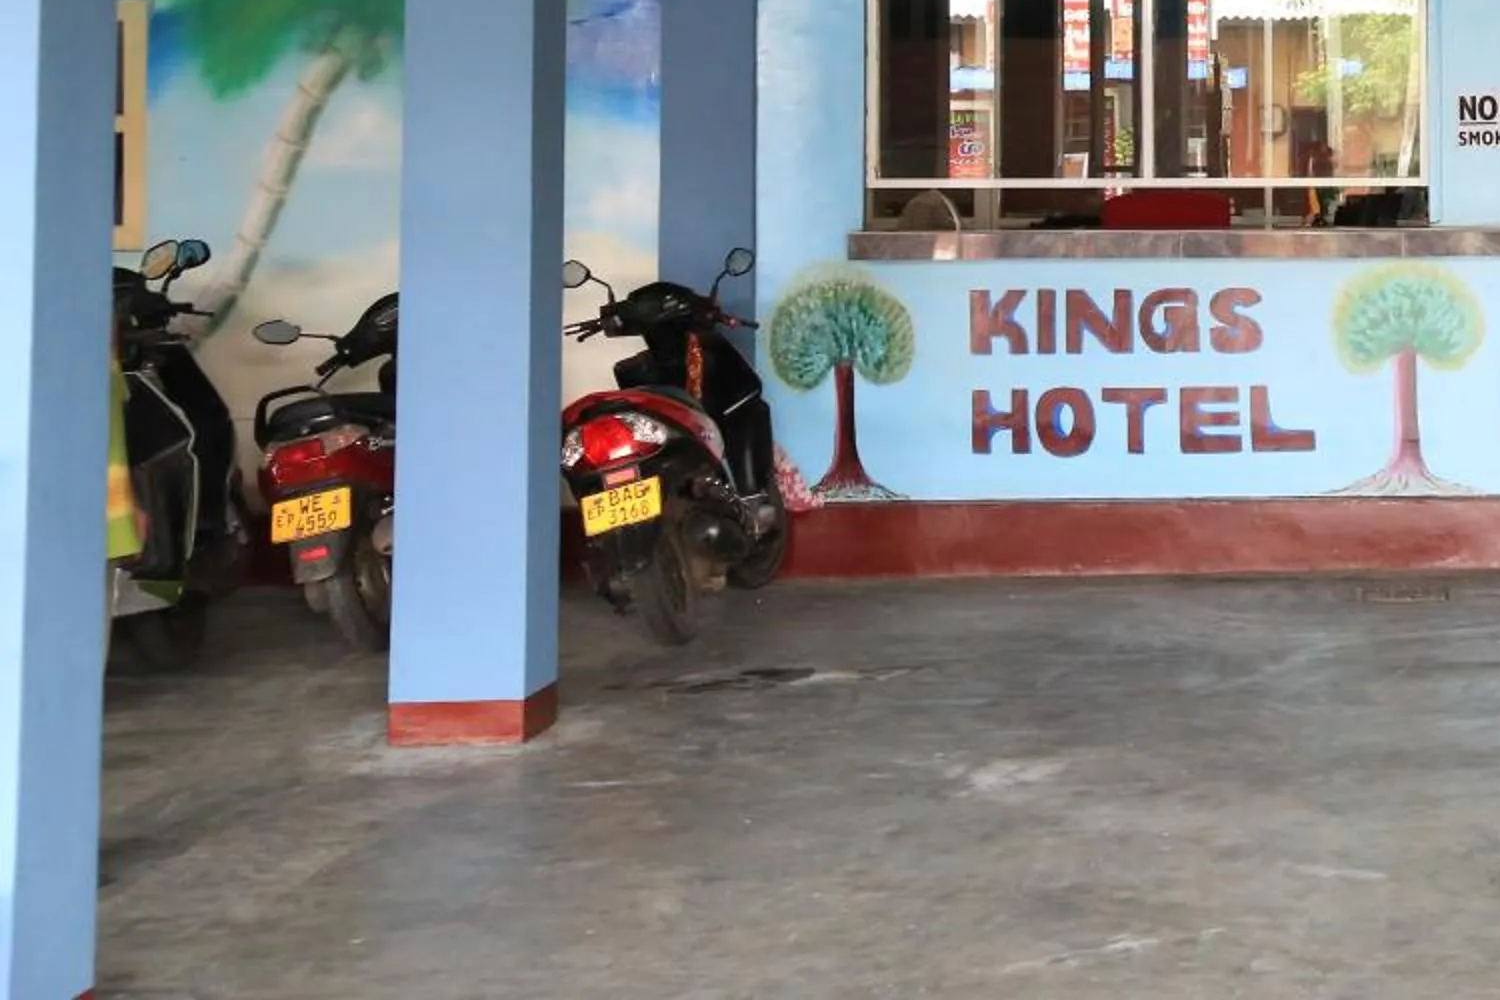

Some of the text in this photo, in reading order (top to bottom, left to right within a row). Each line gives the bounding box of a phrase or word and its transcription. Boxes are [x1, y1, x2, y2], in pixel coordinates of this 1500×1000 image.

[1458, 95, 1498, 121] NO
[969, 287, 1264, 355] KINGS
[971, 385, 1317, 458] HOTEL
[300, 495, 323, 514] WE
[276, 513, 294, 528] EP
